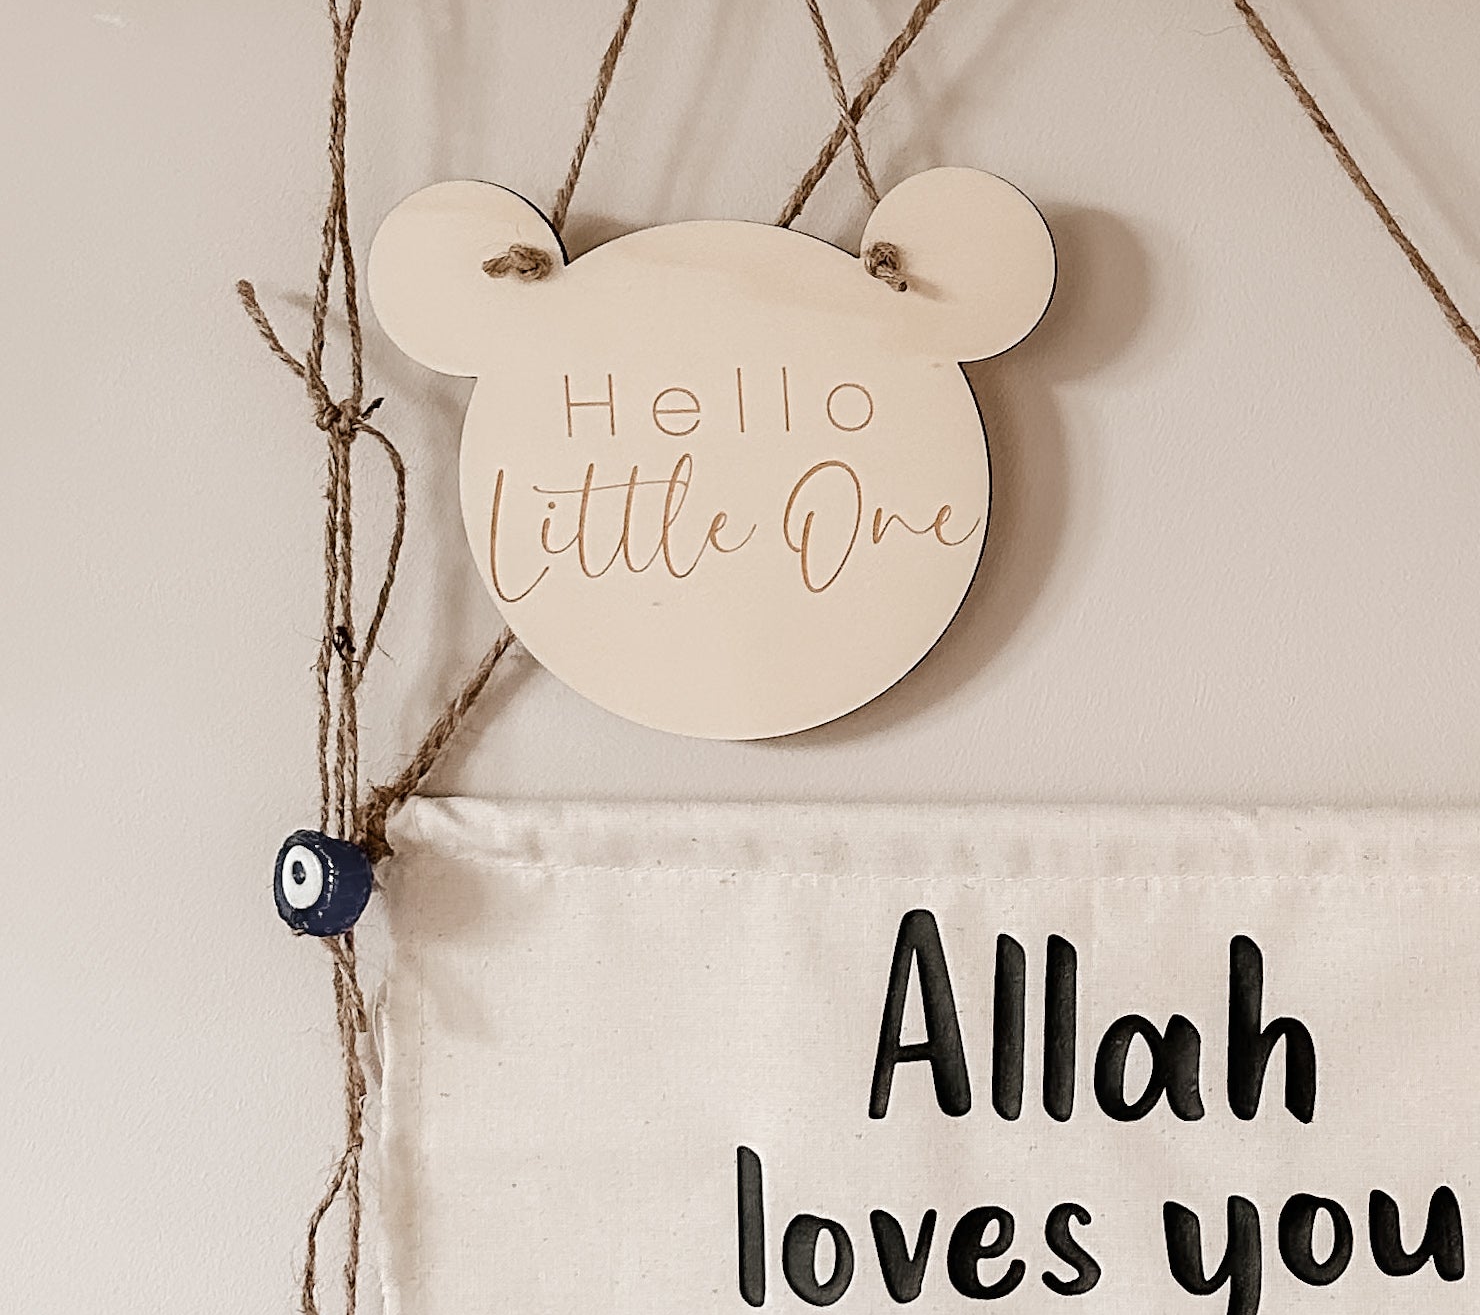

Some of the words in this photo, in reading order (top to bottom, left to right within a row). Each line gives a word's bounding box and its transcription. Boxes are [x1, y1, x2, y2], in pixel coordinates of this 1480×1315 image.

[563, 367, 873, 437] Hello
[490, 453, 757, 603] Little
[783, 460, 982, 594] One
[868, 908, 1316, 1124] Allah
[736, 1145, 1101, 1307] loves
